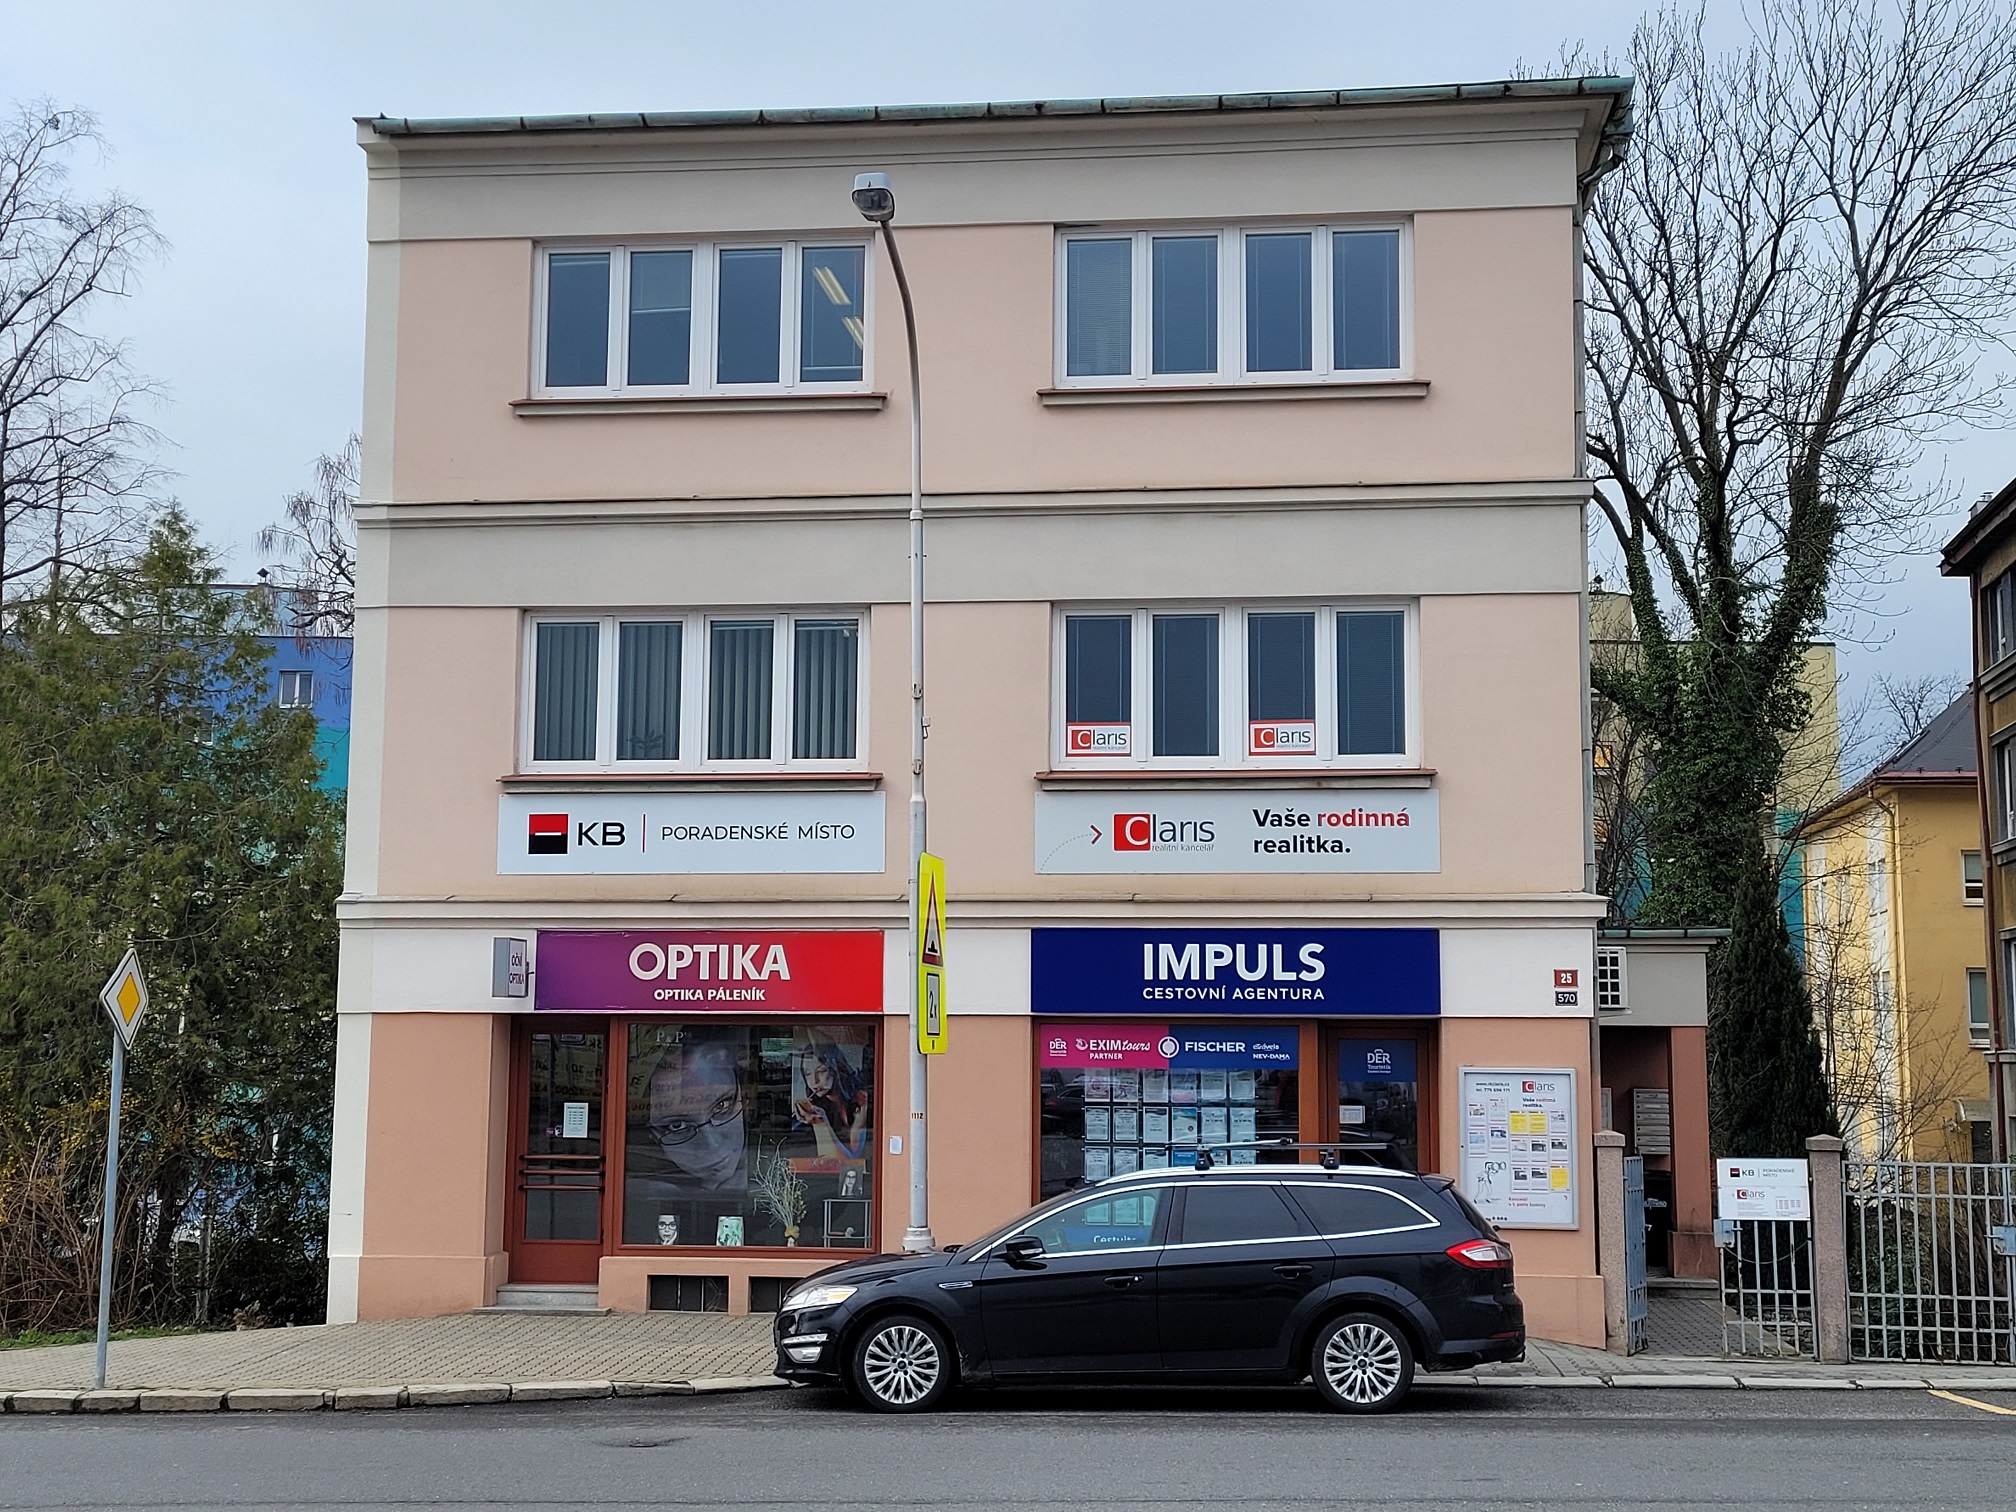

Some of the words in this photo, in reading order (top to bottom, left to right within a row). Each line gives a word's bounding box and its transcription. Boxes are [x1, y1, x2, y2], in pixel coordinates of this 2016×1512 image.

[1077, 729, 1127, 748] Claris
[1260, 728, 1311, 748] Claris
[1252, 808, 1311, 828] Vaše
[1317, 808, 1411, 828] rodinná
[577, 822, 626, 846] KB
[661, 822, 789, 841] PORADENSKÉ
[798, 820, 856, 840] MÍSTO
[1124, 814, 1215, 846] Claris
[1253, 835, 1351, 855] realitka.
[629, 942, 791, 981] OPTIKA
[1143, 943, 1326, 982] IMPULS
[1561, 973, 1572, 984] 25
[654, 989, 704, 1001] OPTIKA
[707, 987, 766, 1001] PÁLENÍK
[1143, 984, 1227, 1000] CESTOVNÍ
[1232, 987, 1326, 1000] AGENTURA
[1558, 993, 1576, 1003] 570
[1185, 1041, 1246, 1052] FISCHER
[1367, 1051, 1391, 1064] DER
[1742, 1169, 1754, 1177] KB
